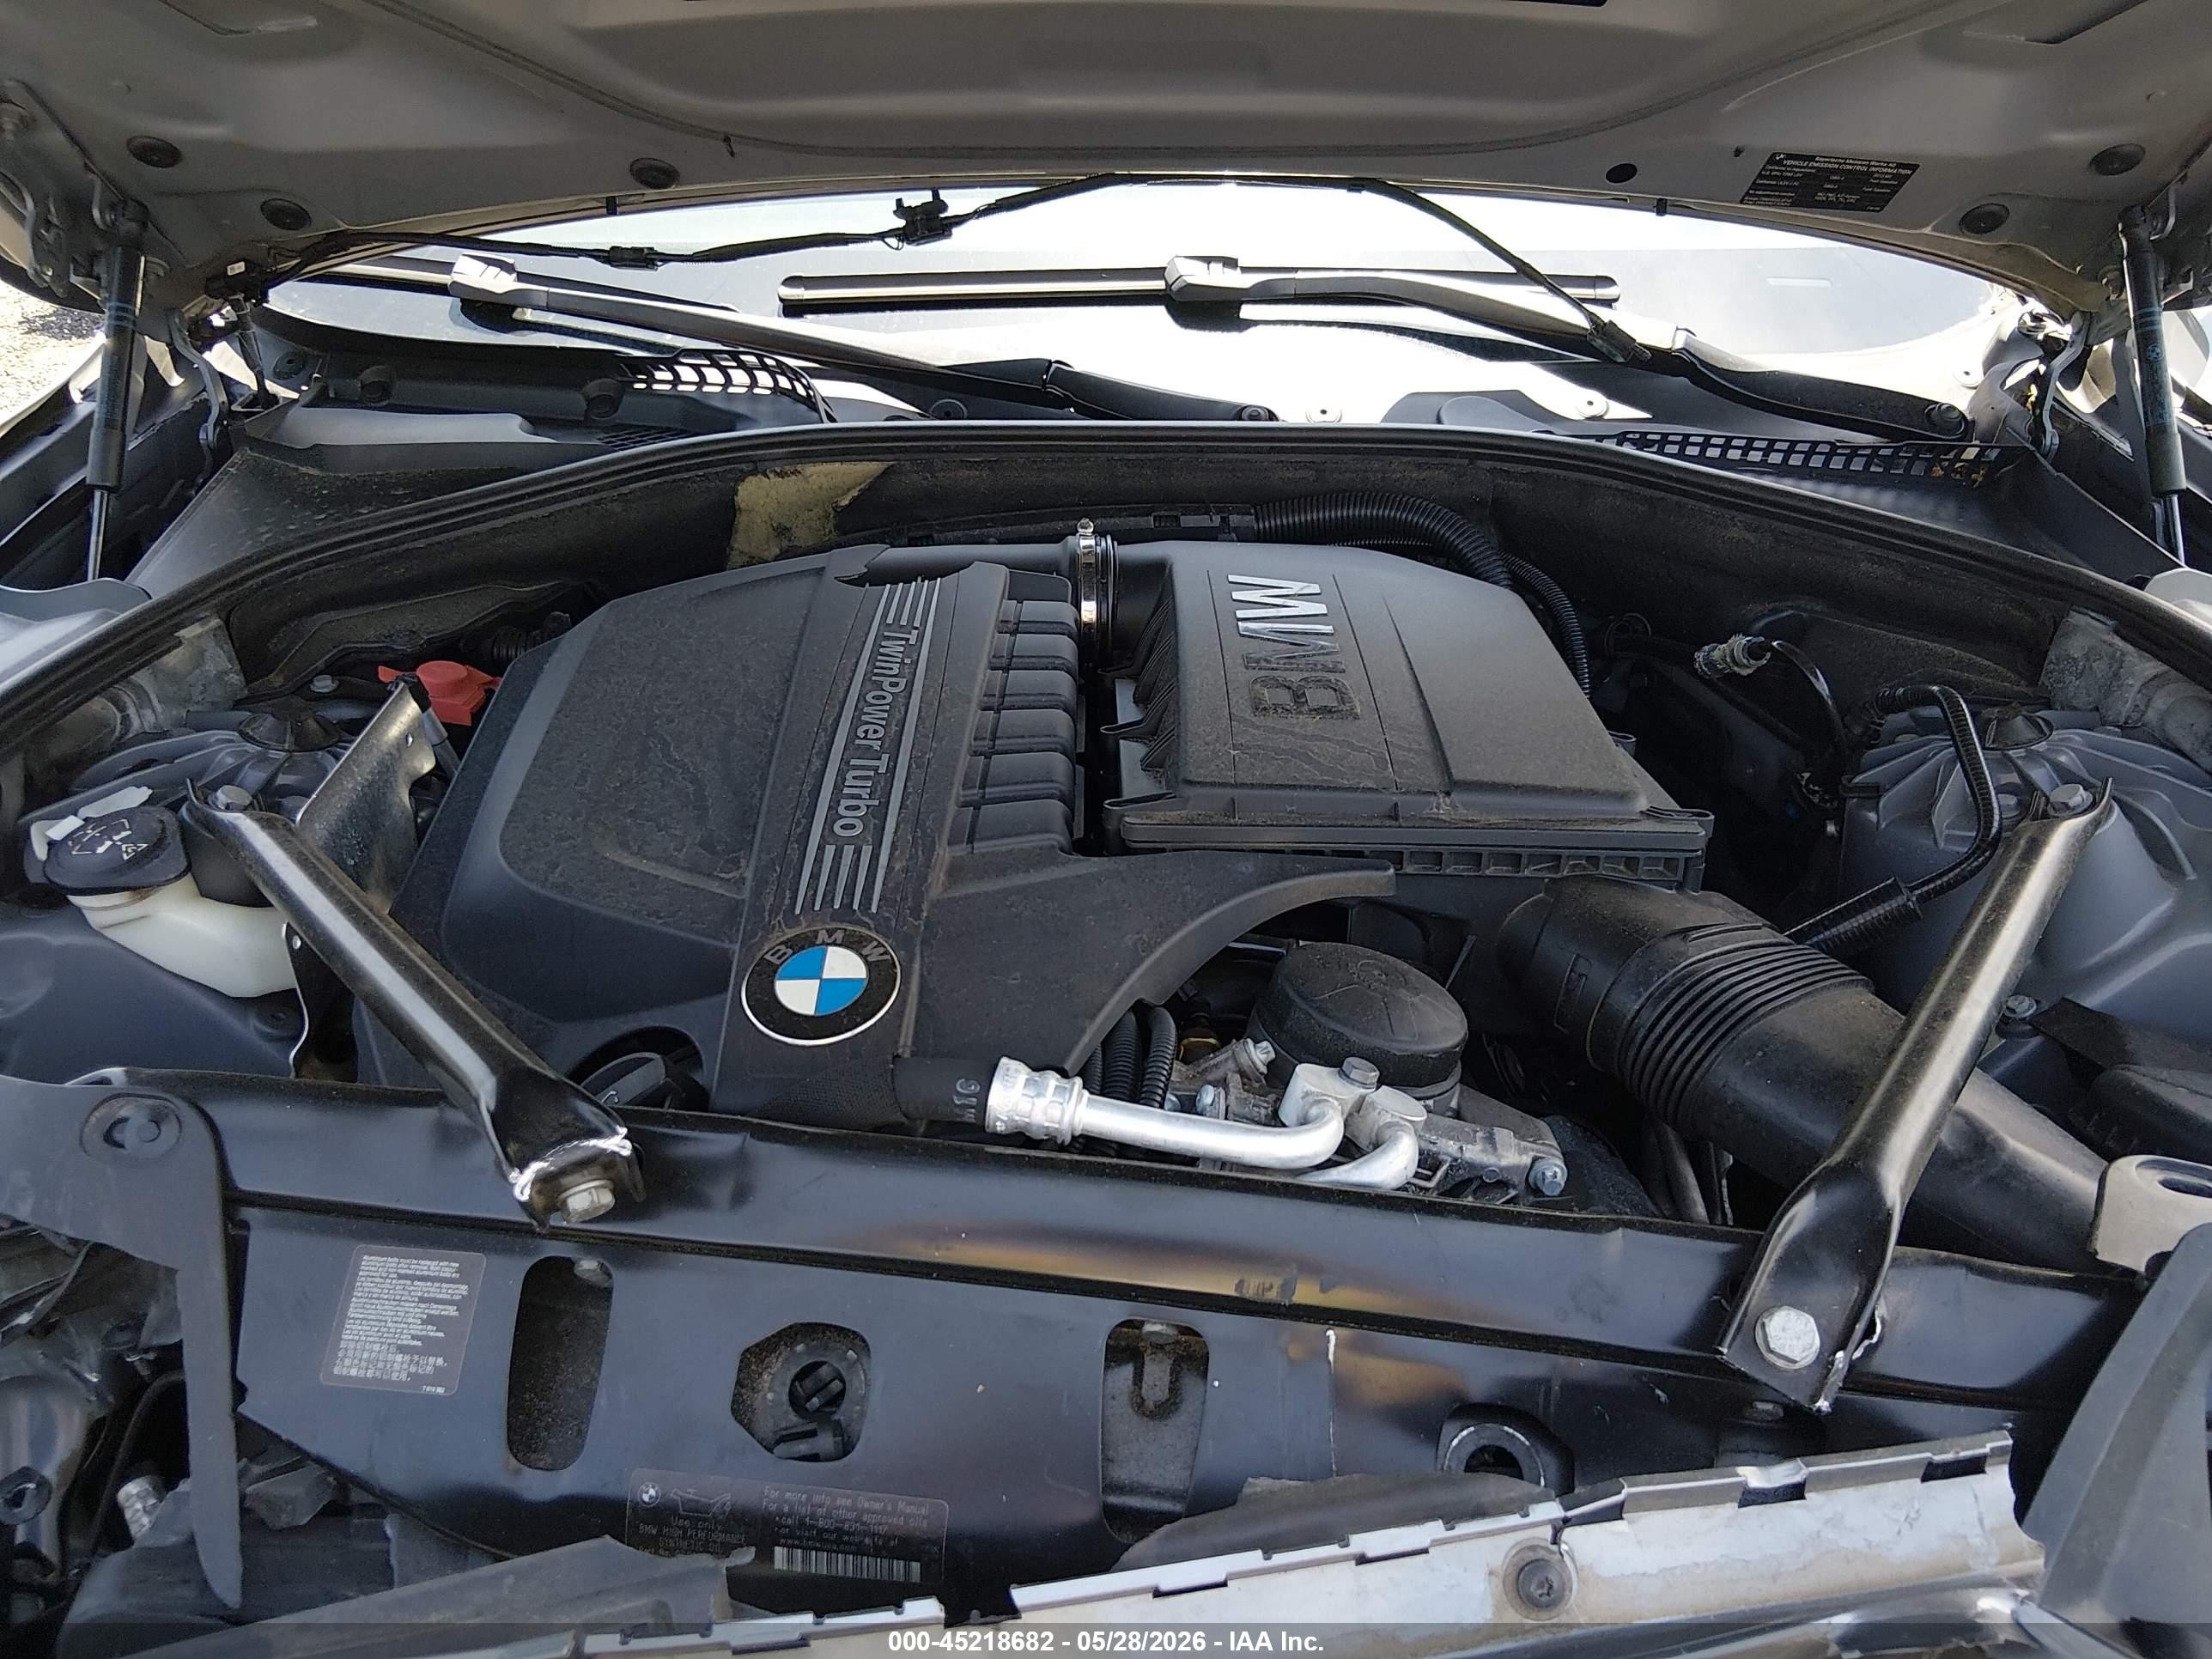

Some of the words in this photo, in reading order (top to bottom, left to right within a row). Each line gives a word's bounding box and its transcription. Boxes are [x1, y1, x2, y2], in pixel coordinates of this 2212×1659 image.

[1227, 574, 1361, 720] BMW
[855, 628, 918, 750] TwinPower
[832, 752, 891, 838] Turbo
[766, 929, 891, 965] BMW
[762, 1498, 778, 1510] For
[763, 1486, 780, 1498] For
[784, 1490, 807, 1502] more
[639, 1522, 659, 1535] BMW
